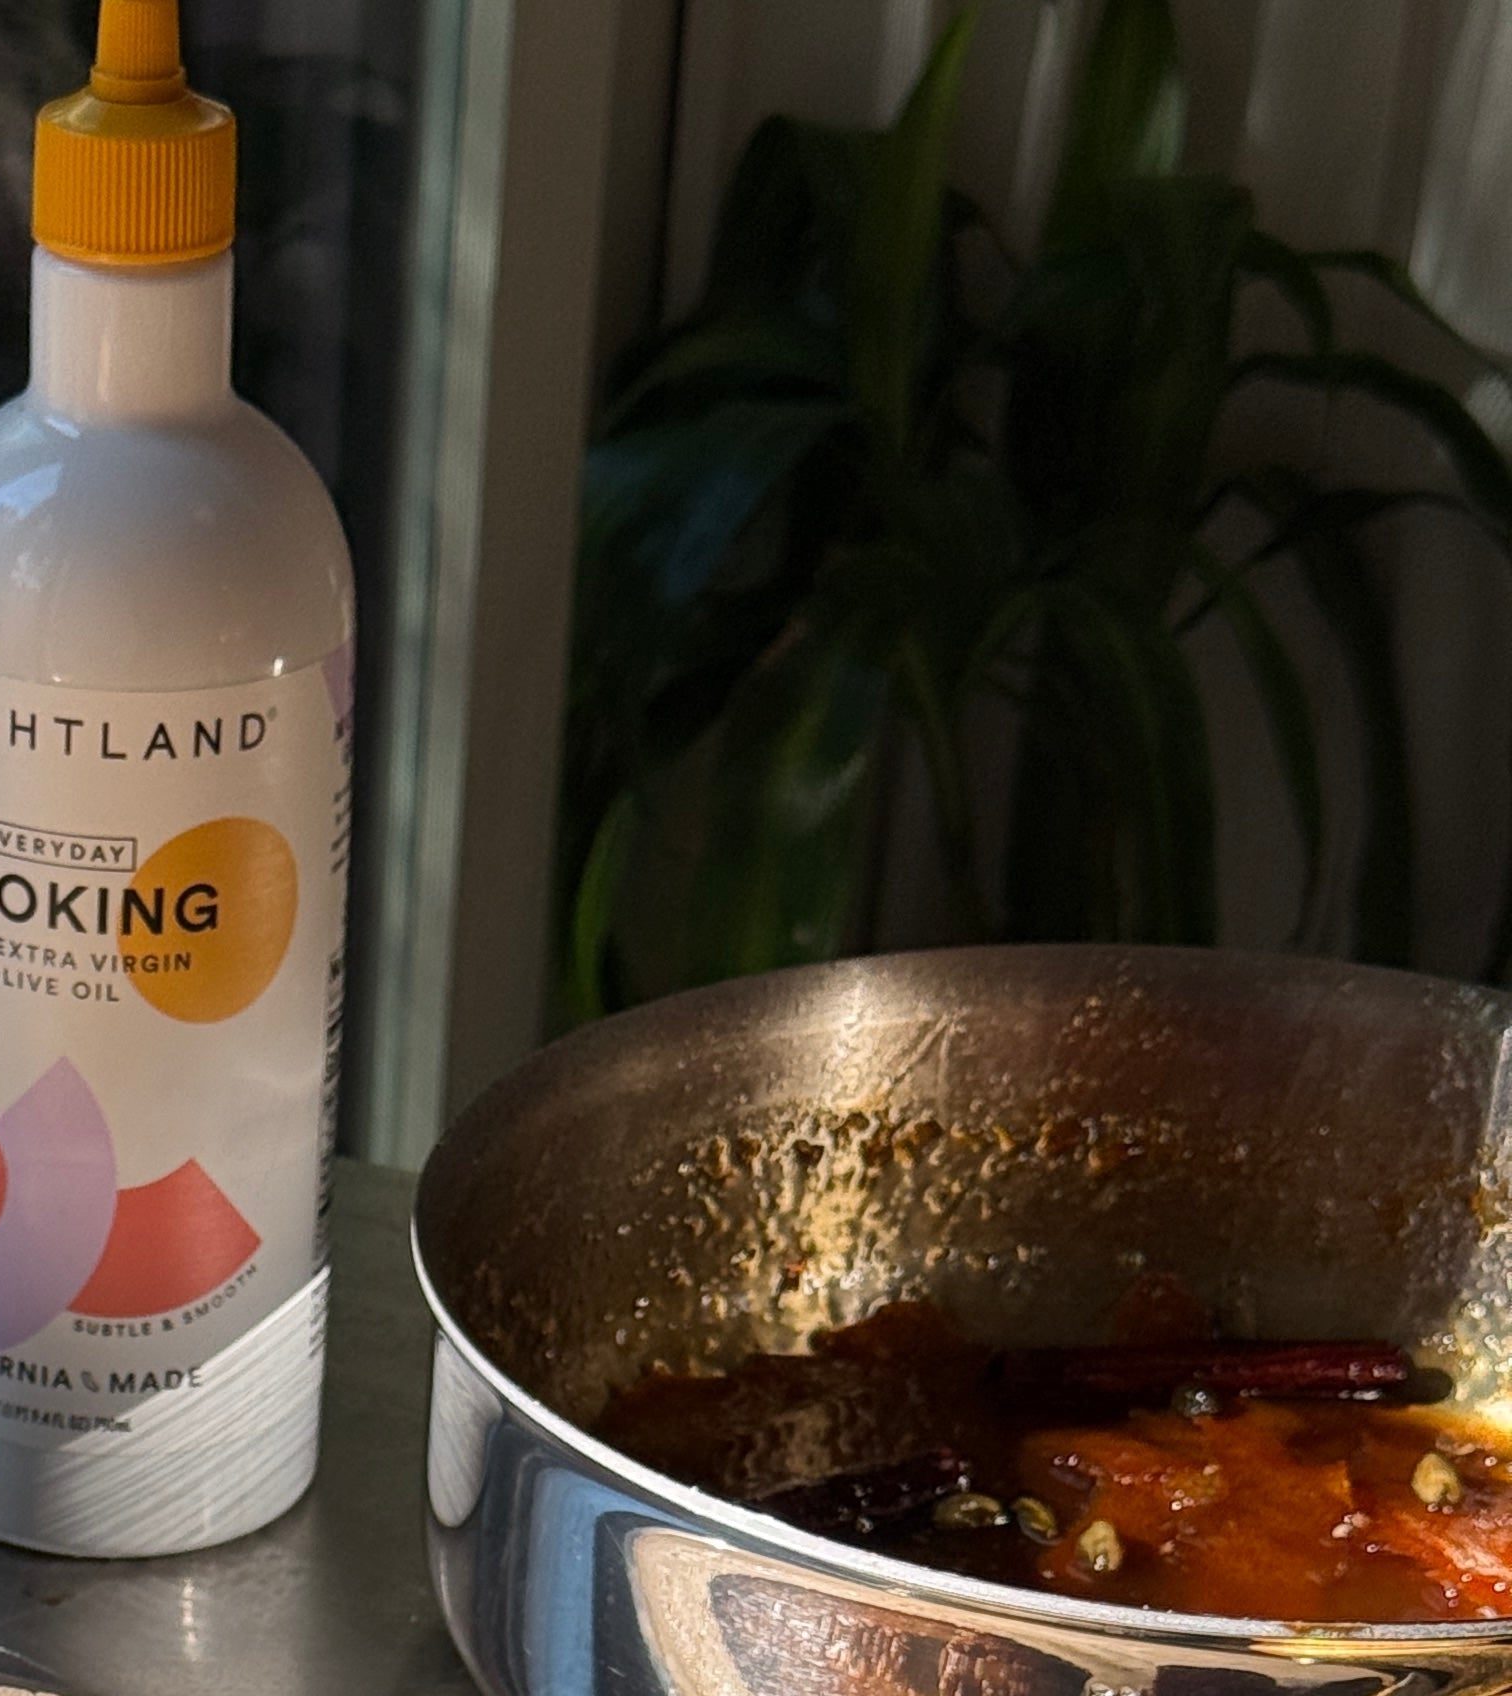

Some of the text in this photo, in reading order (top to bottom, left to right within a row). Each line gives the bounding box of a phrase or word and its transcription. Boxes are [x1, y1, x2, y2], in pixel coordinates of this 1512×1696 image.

[90, 952, 193, 974] VIRGIN
[71, 981, 121, 1003] OIL
[73, 1263, 258, 1338] SUBTLE & SMOOTH
[109, 1366, 204, 1395] MADE
